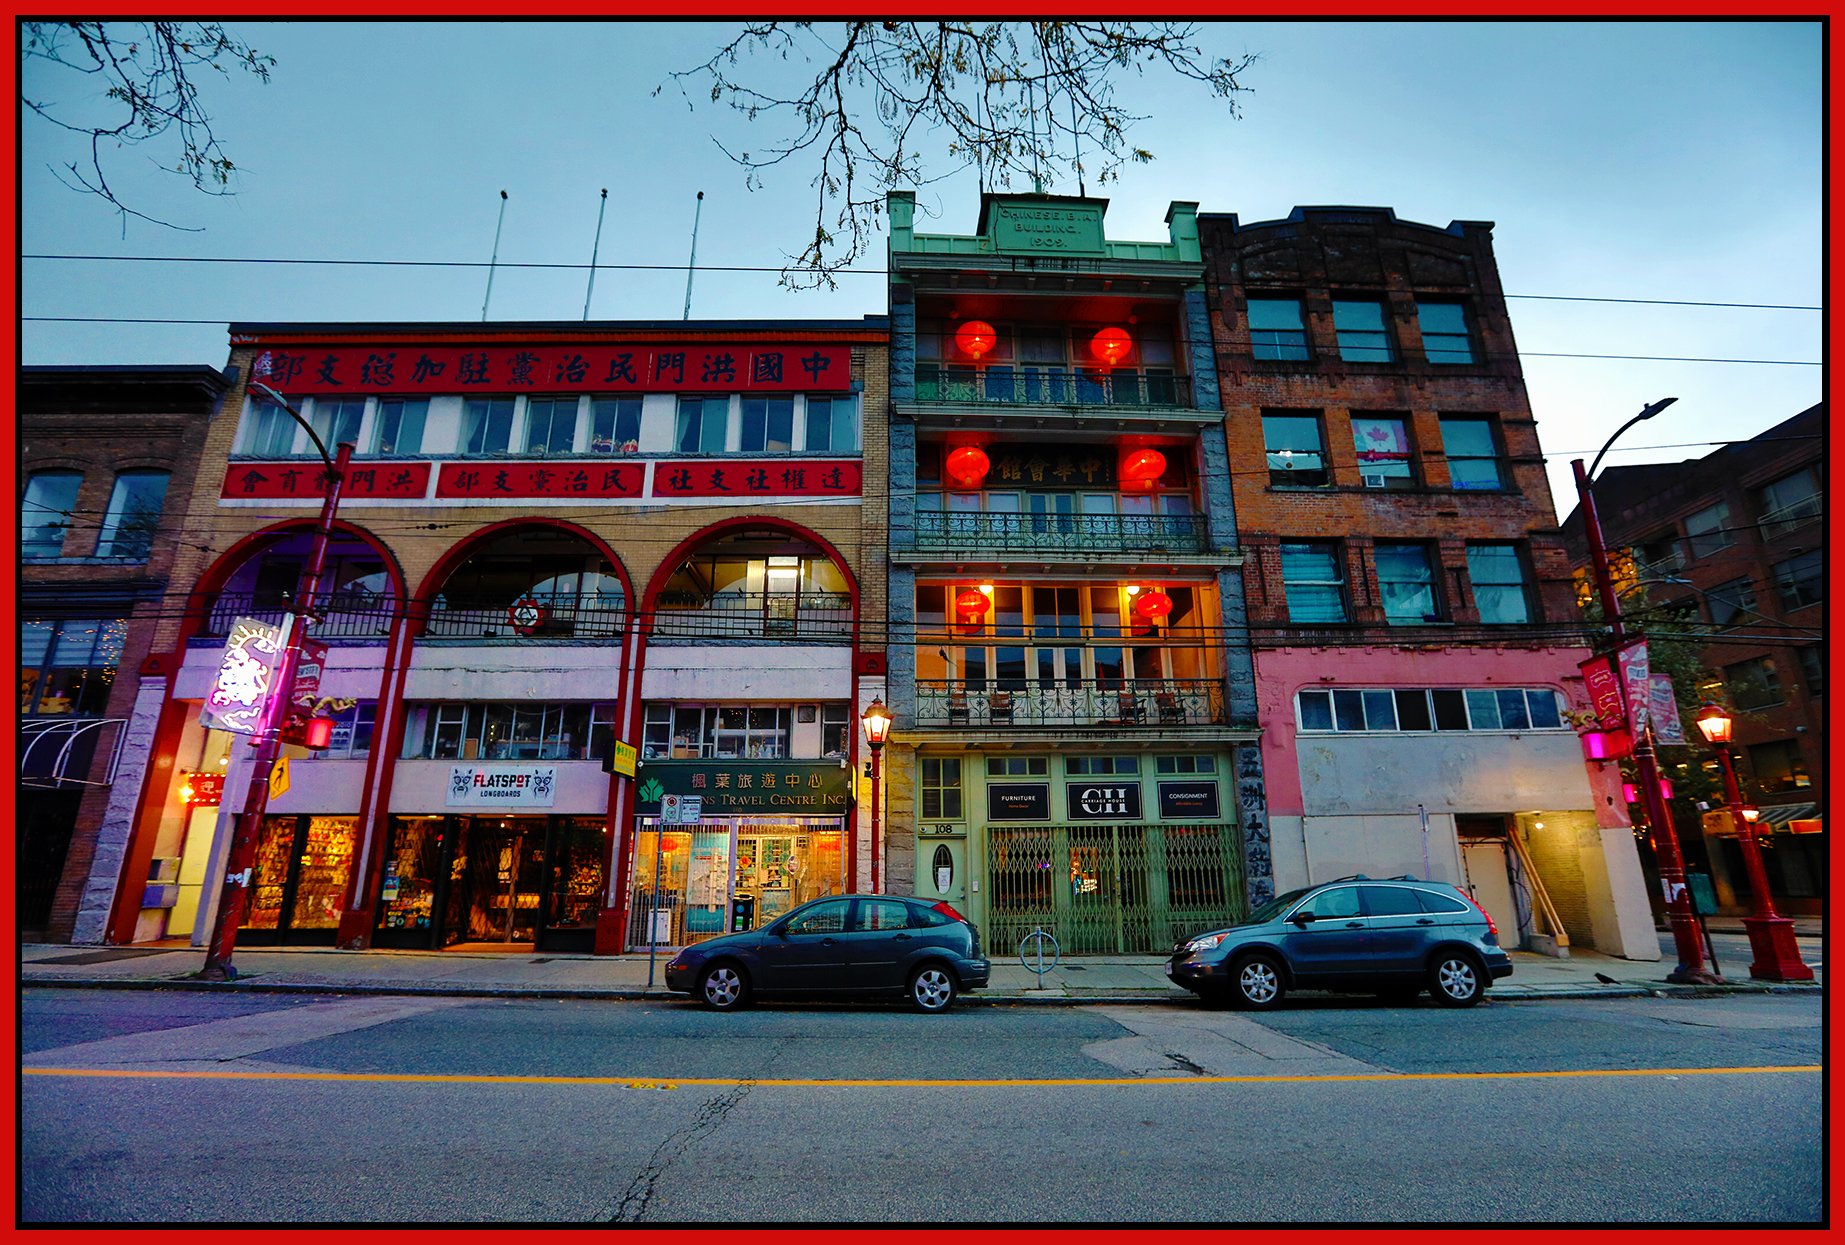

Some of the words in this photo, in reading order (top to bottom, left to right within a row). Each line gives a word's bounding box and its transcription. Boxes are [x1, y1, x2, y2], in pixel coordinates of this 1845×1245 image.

[473, 774, 532, 788] FLATSPOT
[691, 773, 824, 789] 楓葉旅遊中心
[480, 790, 521, 798] LONGBOARDS
[720, 794, 766, 806] TRAVEL
[770, 793, 818, 806] CENTRE
[1081, 788, 1128, 814] CH
[935, 824, 953, 834] 108
